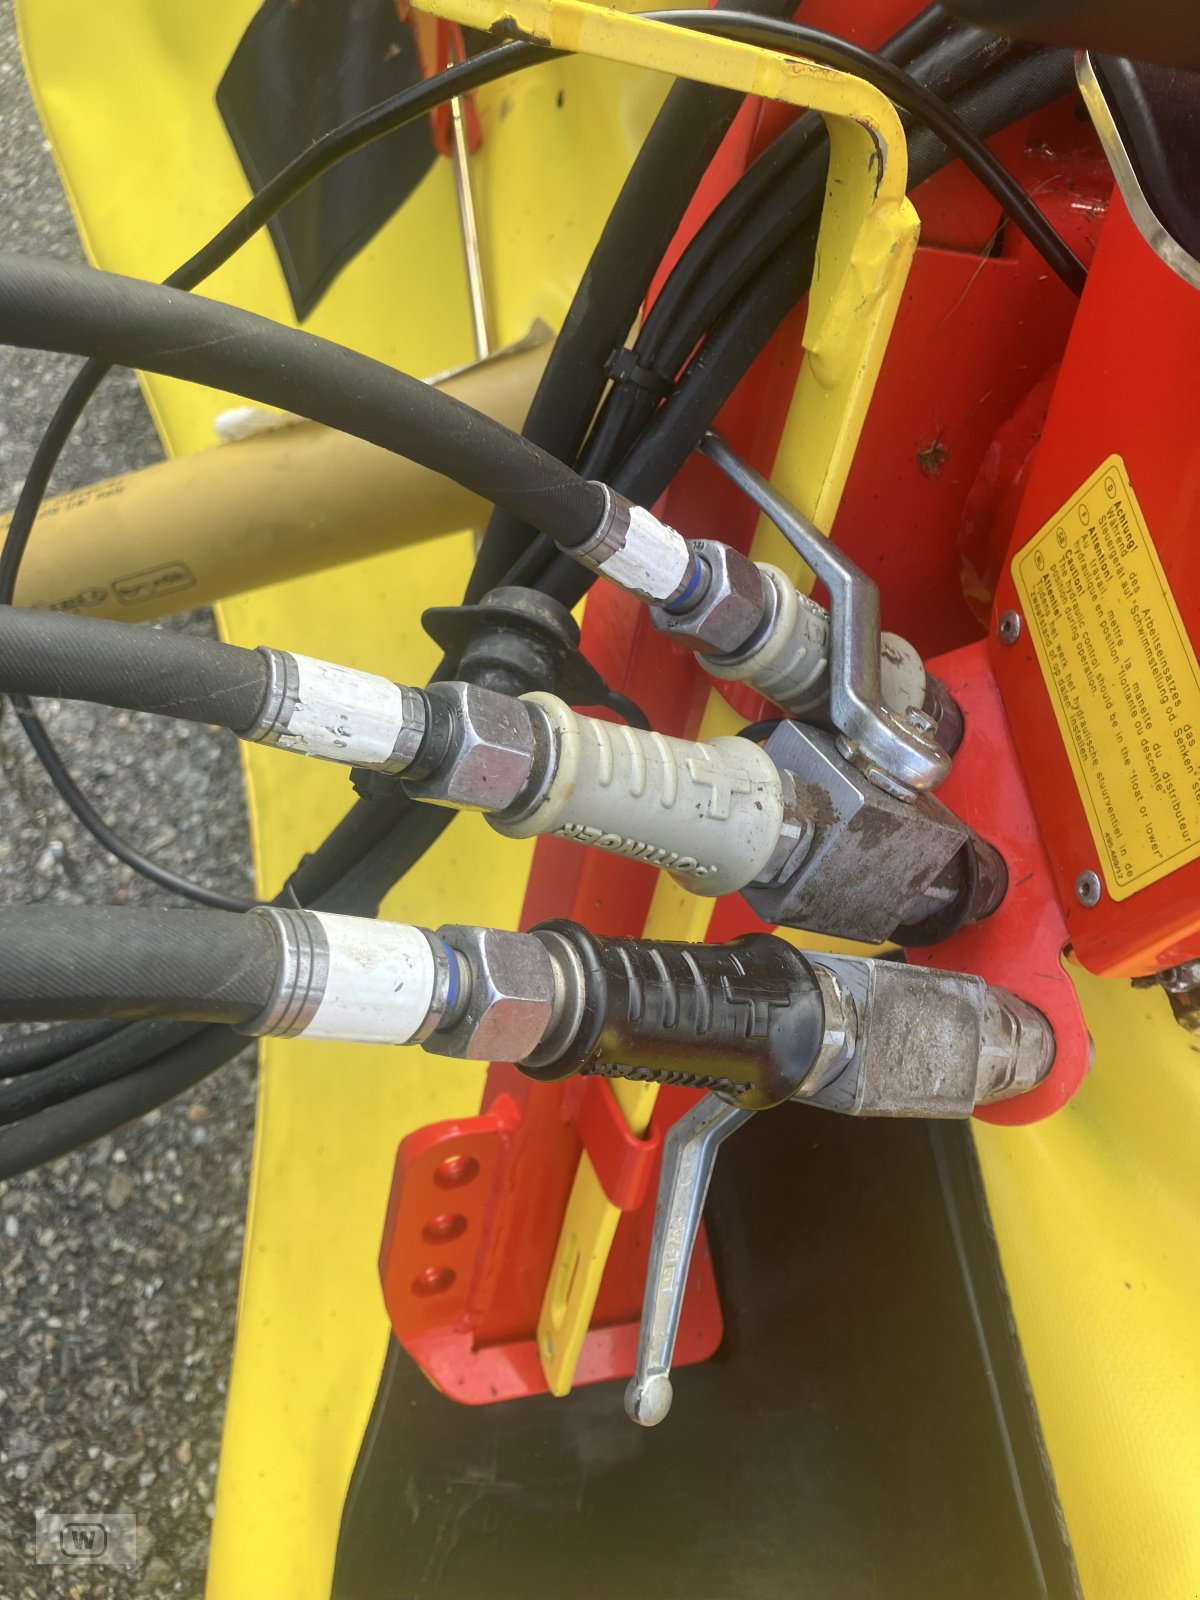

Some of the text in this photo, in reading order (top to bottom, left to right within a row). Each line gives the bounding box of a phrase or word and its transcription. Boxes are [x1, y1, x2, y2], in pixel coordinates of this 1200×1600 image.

[1064, 548, 1086, 598] Caution!
[1087, 526, 1114, 583] Attention!
[1112, 500, 1139, 553] Achtung!
[1042, 572, 1063, 621] Attentie!
[1049, 563, 1068, 605] position
[1064, 606, 1080, 642] during
[1073, 539, 1098, 602] hydraulique
[1098, 619, 1120, 665] position
[1117, 664, 1138, 718] "flottante
[1098, 514, 1126, 580] Steuergerät
[1130, 599, 1173, 705] "Schwimmstellung
[1173, 727, 1198, 776] Senken"
[1141, 608, 1182, 708] Arbeitseinsatzes
[1033, 578, 1051, 617] Tijdens
[1056, 643, 1069, 670] werk
[1096, 771, 1124, 839] stuurventiel
[1065, 579, 1086, 629] hydraulic
[1082, 631, 1101, 670] control
[1095, 672, 1114, 710] should
[1129, 768, 1144, 803] "float
[1144, 822, 1164, 859] lower"
[1107, 609, 1124, 647] mettre
[1132, 681, 1153, 730] manette
[1162, 771, 1192, 843] distributeur
